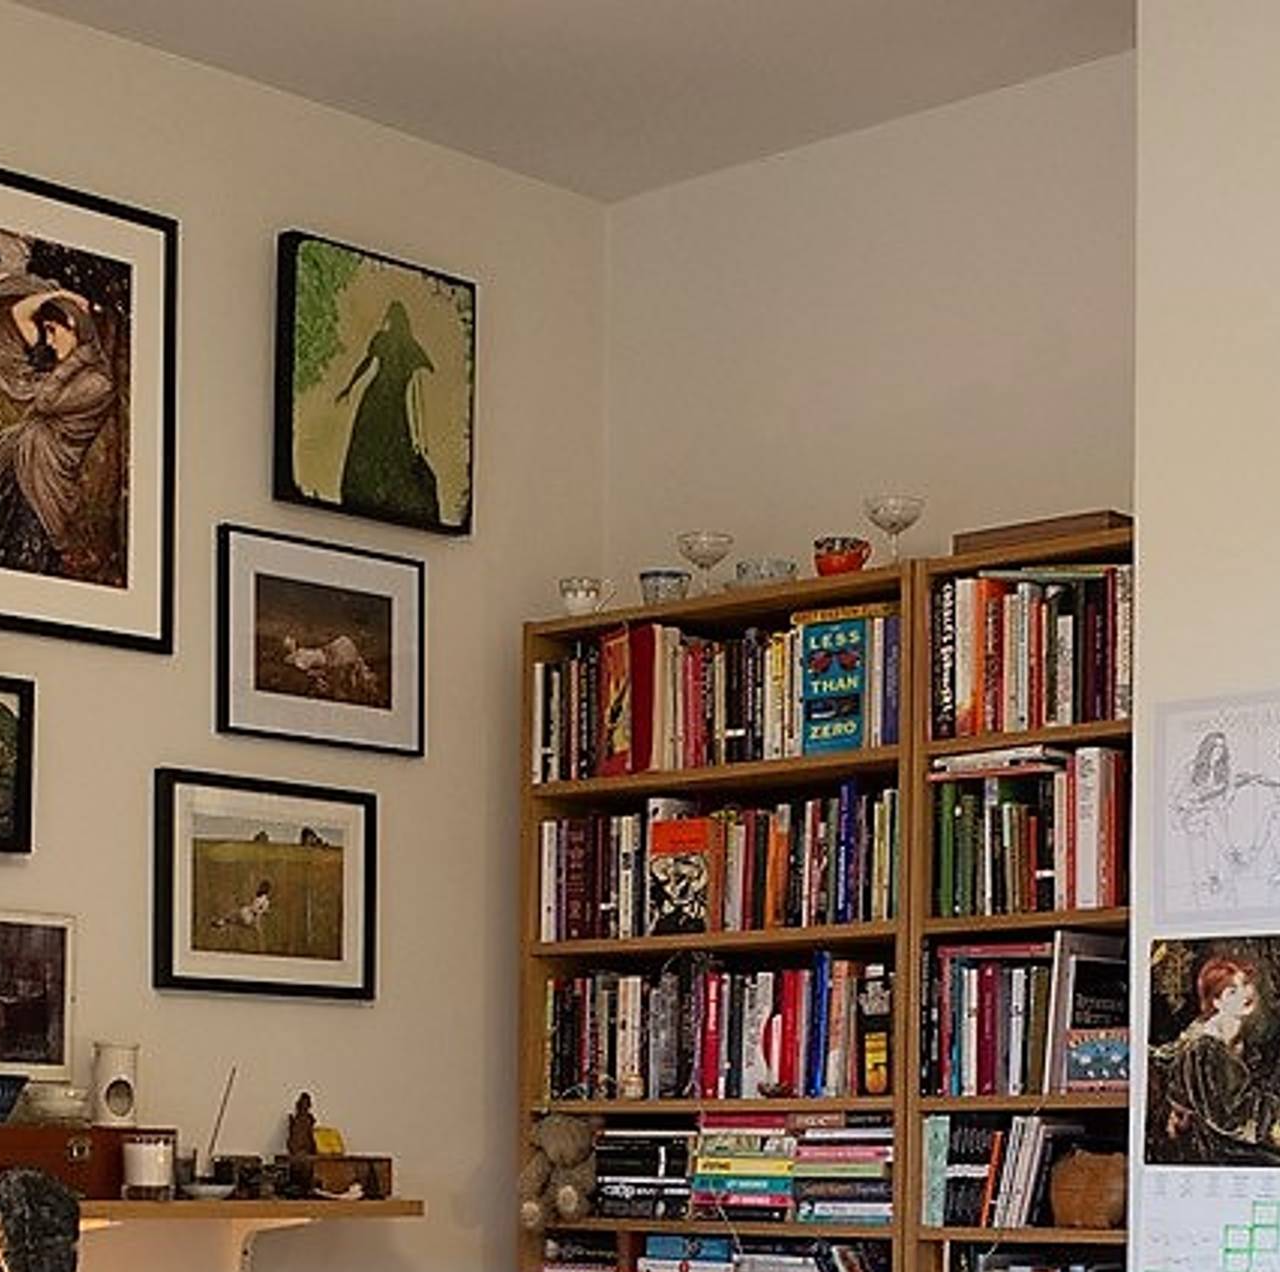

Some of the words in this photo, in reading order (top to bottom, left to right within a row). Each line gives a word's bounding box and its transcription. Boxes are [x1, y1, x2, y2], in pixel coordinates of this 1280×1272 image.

[809, 629, 861, 650] LESS
[809, 675, 861, 695] THAN
[808, 720, 857, 741] ZERO
